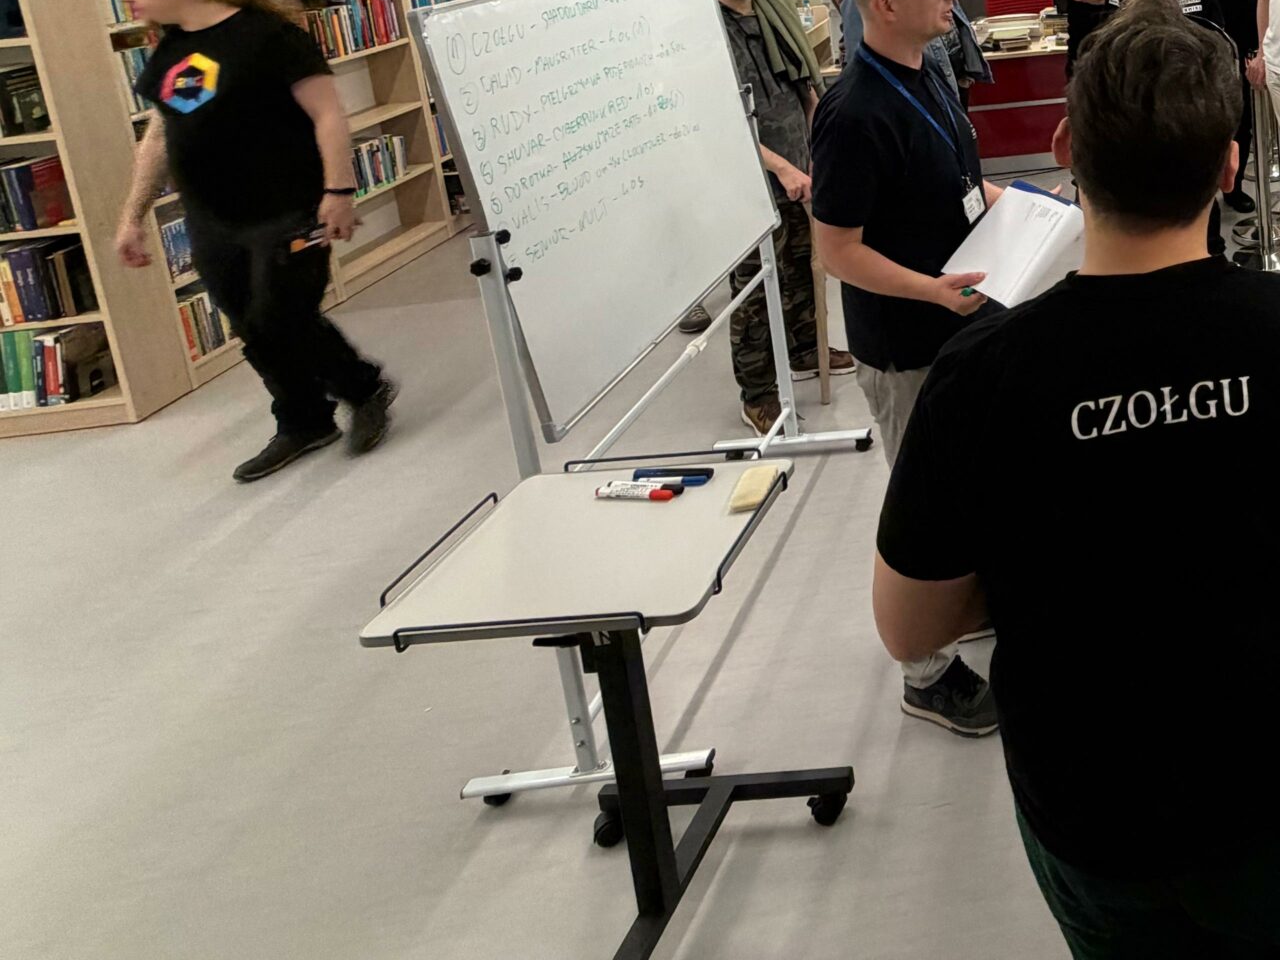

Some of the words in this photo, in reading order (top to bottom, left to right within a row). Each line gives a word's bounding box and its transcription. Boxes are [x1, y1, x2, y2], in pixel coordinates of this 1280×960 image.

[490, 105, 532, 138] RUDY
[608, 95, 629, 116] RED
[1071, 375, 1251, 440] CZOŁGU
